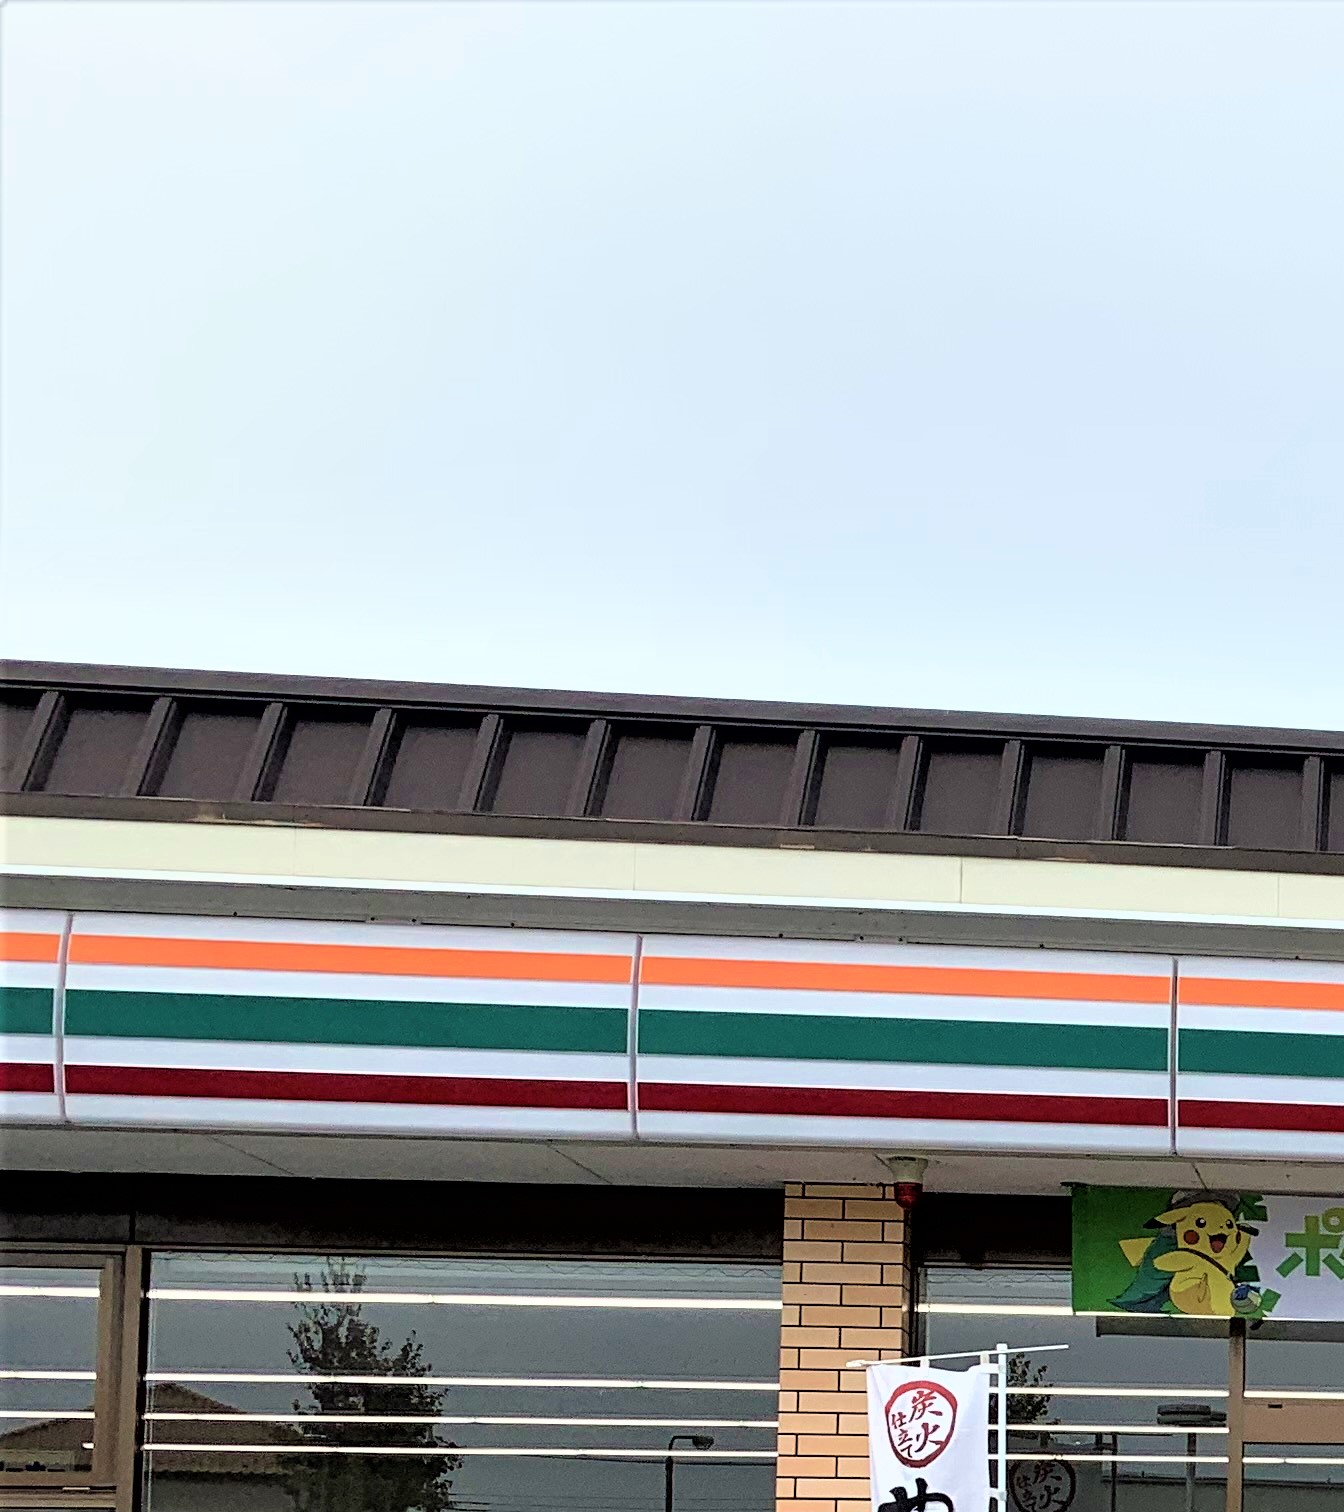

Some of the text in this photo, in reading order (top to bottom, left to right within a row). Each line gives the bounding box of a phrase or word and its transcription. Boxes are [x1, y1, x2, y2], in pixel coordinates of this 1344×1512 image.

[891, 1411, 915, 1458] 仕立て
[909, 1390, 944, 1453] 炭火
